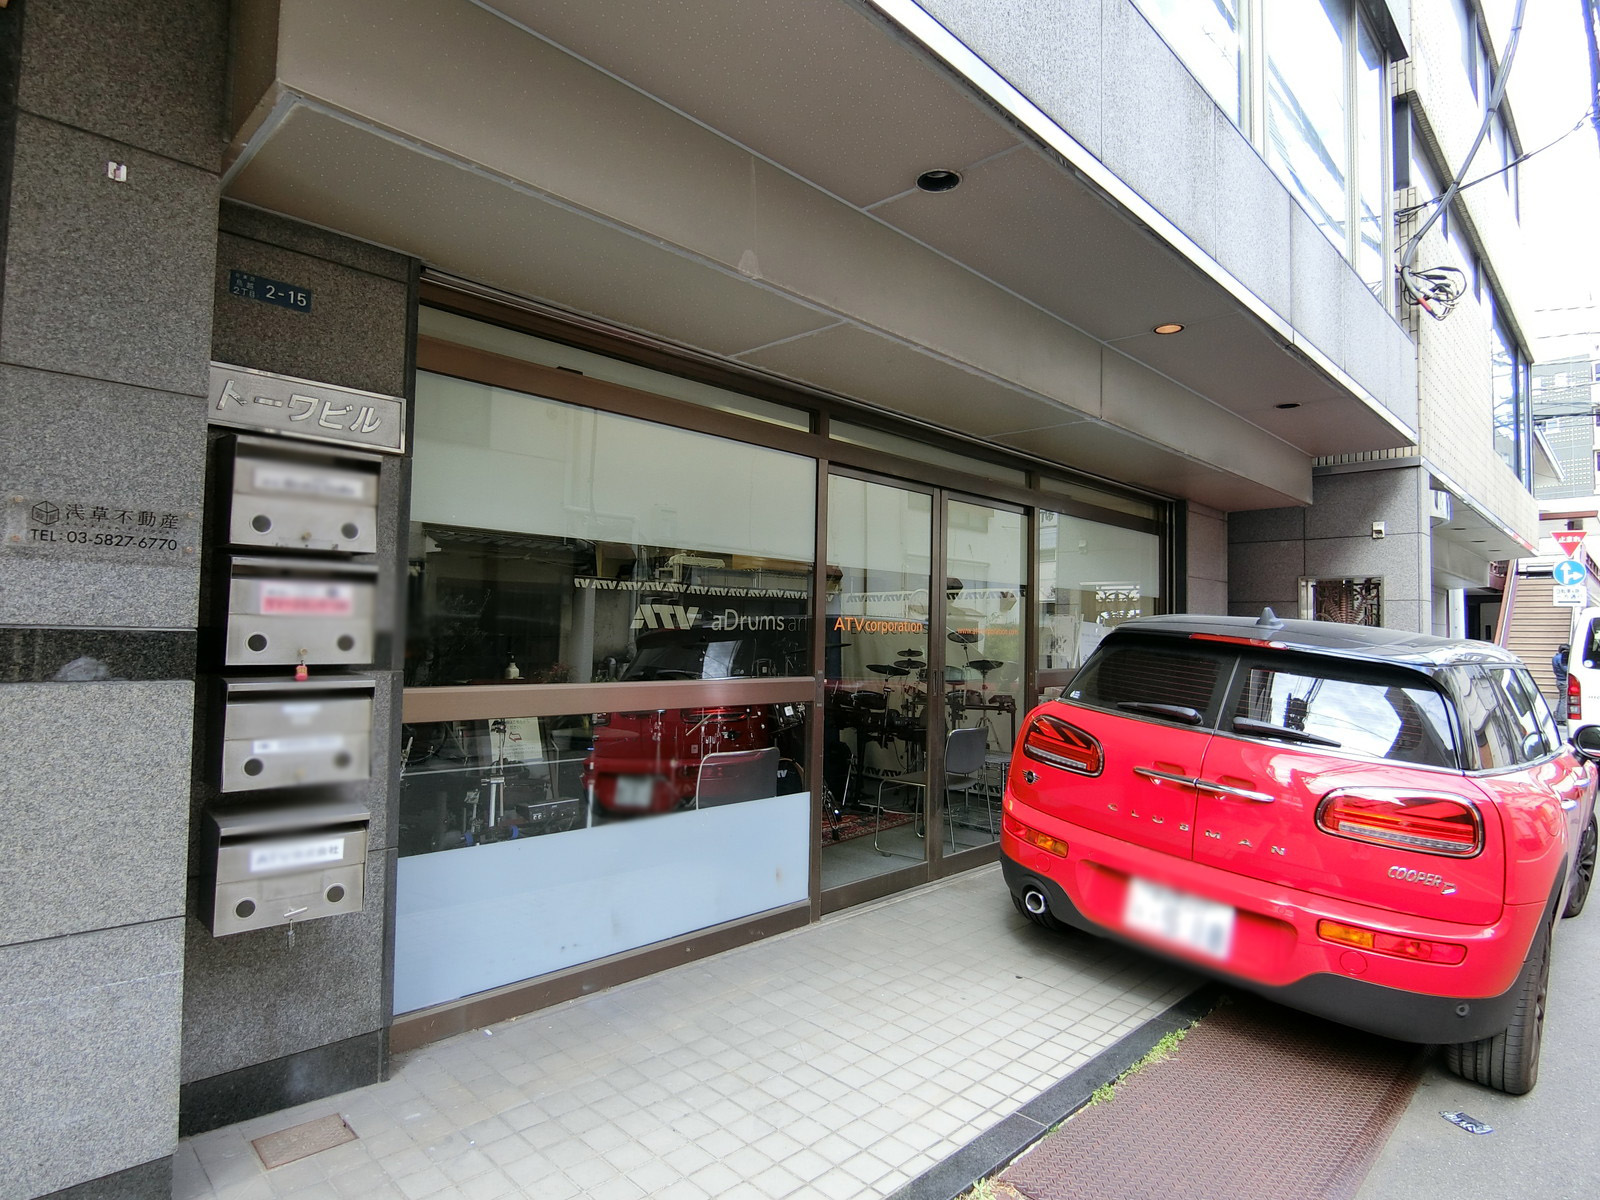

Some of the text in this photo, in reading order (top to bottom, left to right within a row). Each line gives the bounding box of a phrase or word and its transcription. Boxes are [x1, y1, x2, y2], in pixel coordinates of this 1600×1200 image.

[266, 284, 307, 307] 2-15
[217, 379, 382, 433] トーワビル
[65, 503, 179, 530] 浅草不動産
[66, 531, 177, 550] 03-5827-6770
[630, 604, 699, 630] ATV
[711, 608, 785, 632] aDrums
[1107, 803, 1285, 856] CLUBMAN
[1388, 866, 1443, 888] COOPER
